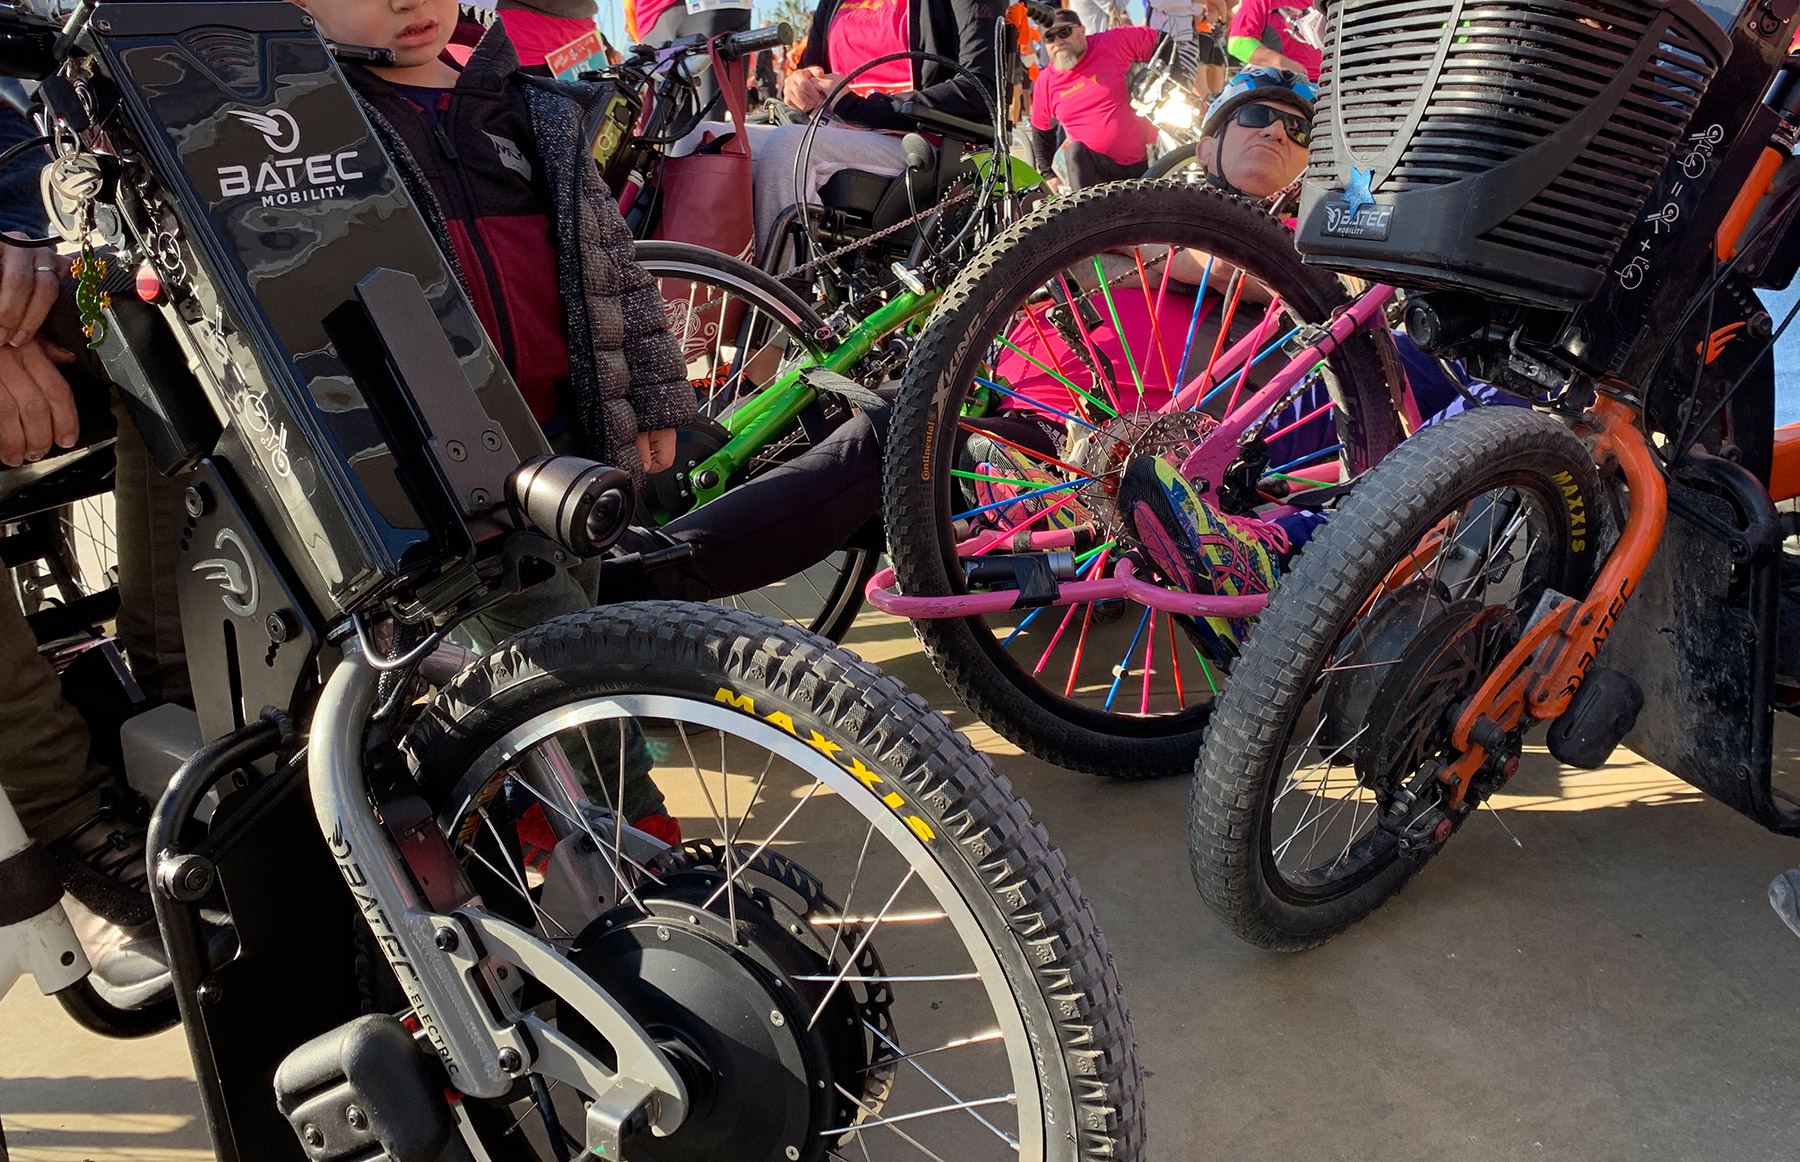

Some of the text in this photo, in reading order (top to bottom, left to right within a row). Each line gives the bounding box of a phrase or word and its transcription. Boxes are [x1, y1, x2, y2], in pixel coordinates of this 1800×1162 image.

[217, 151, 363, 197] BATEC
[261, 185, 345, 207] MOBILITY
[1337, 227, 1364, 235] MOBILITY
[921, 421, 935, 481] Continental
[1552, 470, 1586, 552] MAXXIS
[714, 687, 936, 842] MAXXIS
[340, 863, 419, 982] BATEC
[411, 994, 459, 1076] ELECTRIC
